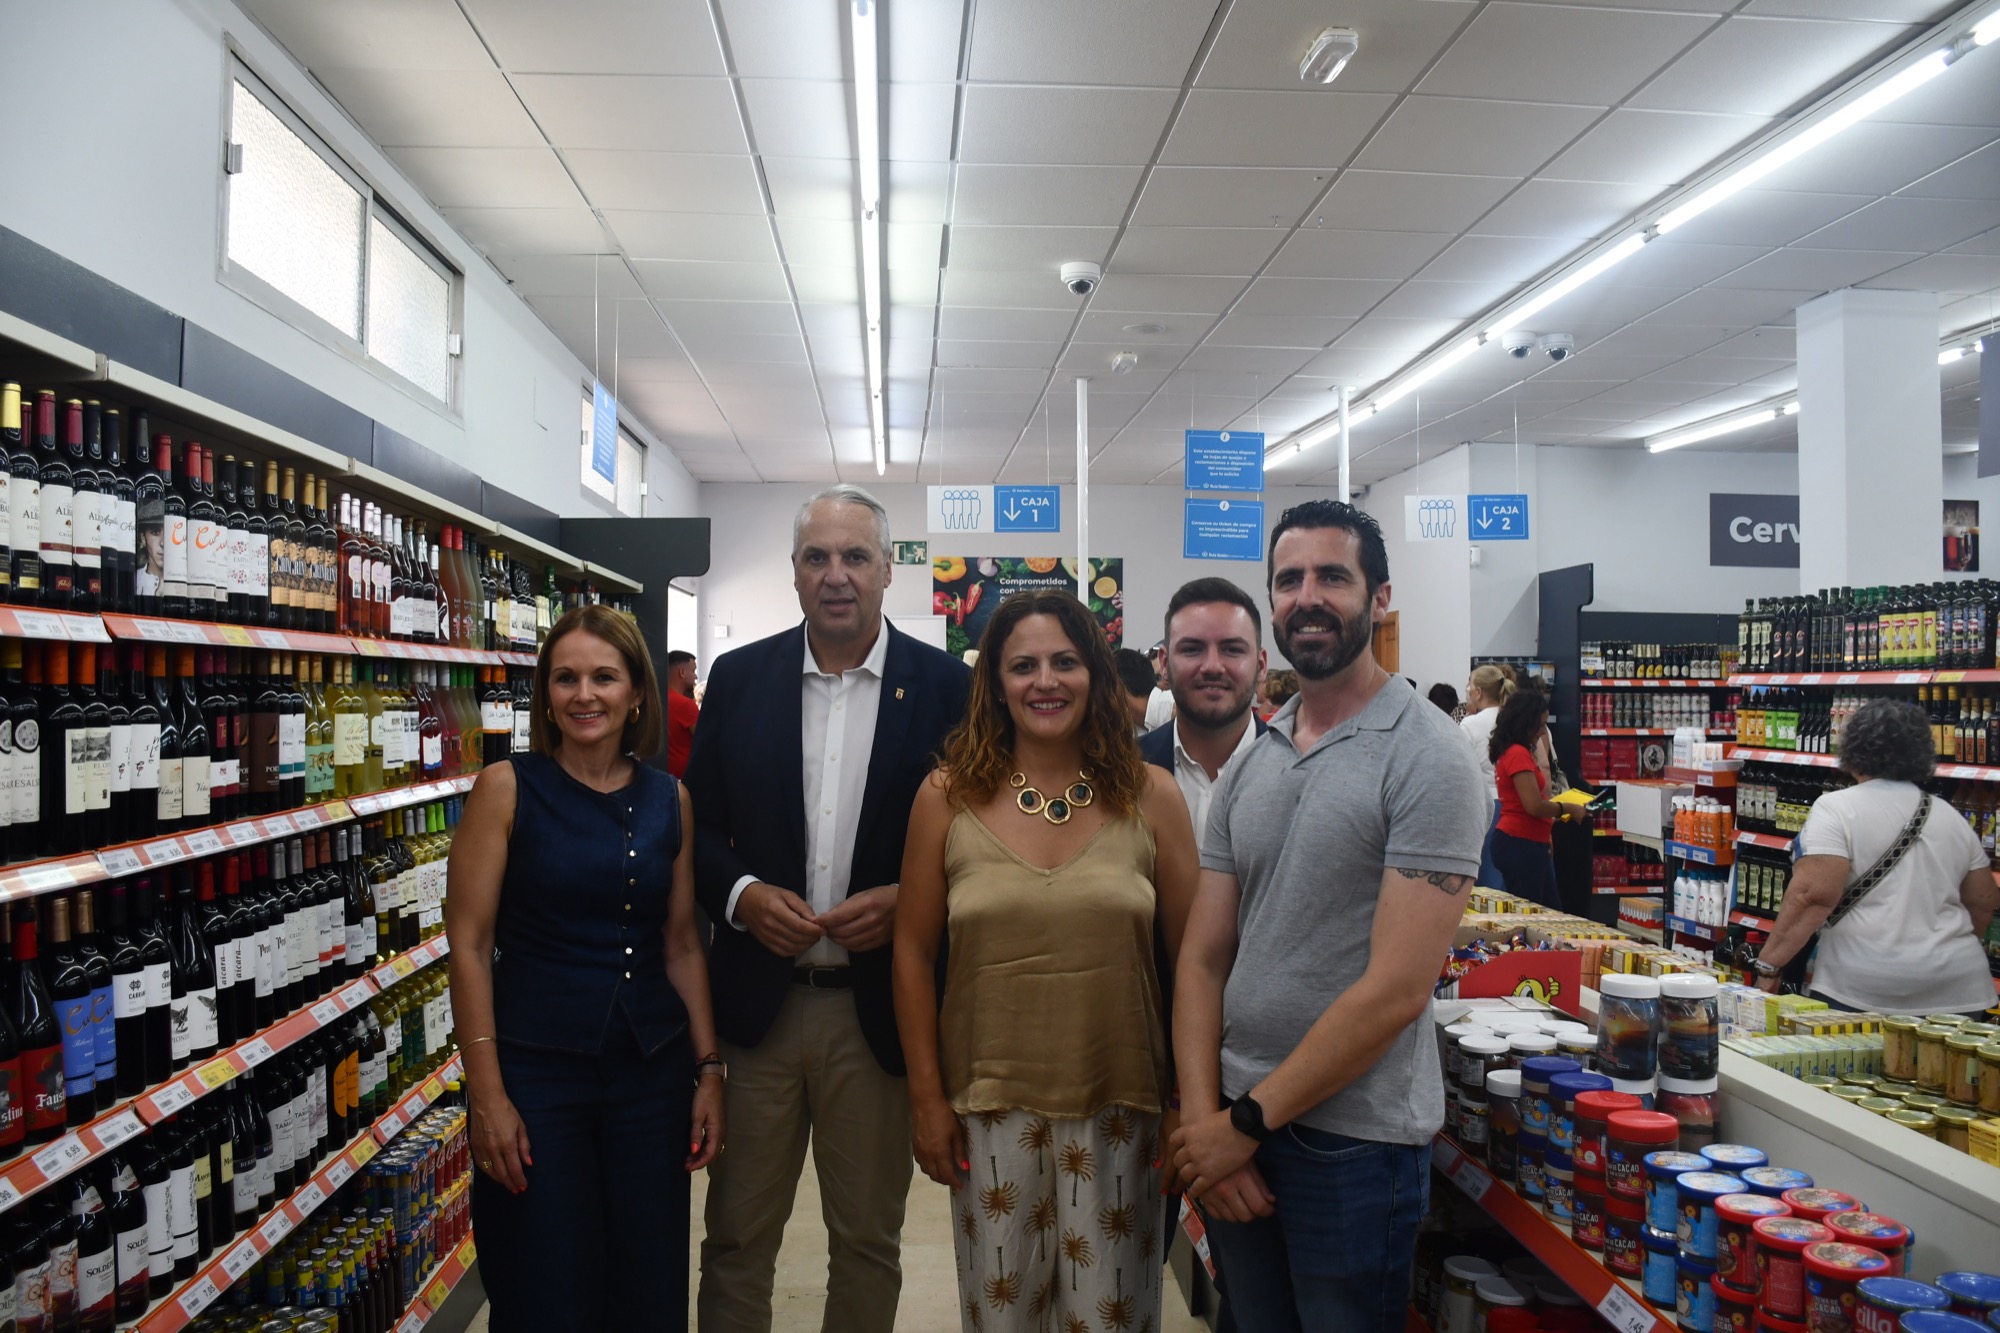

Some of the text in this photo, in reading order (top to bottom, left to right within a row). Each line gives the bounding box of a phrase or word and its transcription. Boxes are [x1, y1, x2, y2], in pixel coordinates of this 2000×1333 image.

[1021, 497, 1049, 506] CAJA
[1032, 509, 1038, 522] 1
[1493, 506, 1519, 515] CAJA
[1502, 517, 1510, 530] 2
[1000, 577, 1067, 586] Comprometidos
[65, 1144, 80, 1158] 6,99
[1618, 1163, 1639, 1173] CACAO
[1579, 1212, 1598, 1223] CACAO
[1614, 1239, 1636, 1249] CACAO
[1814, 1303, 1841, 1318] CACAO
[1628, 1317, 1644, 1333] 1,45
